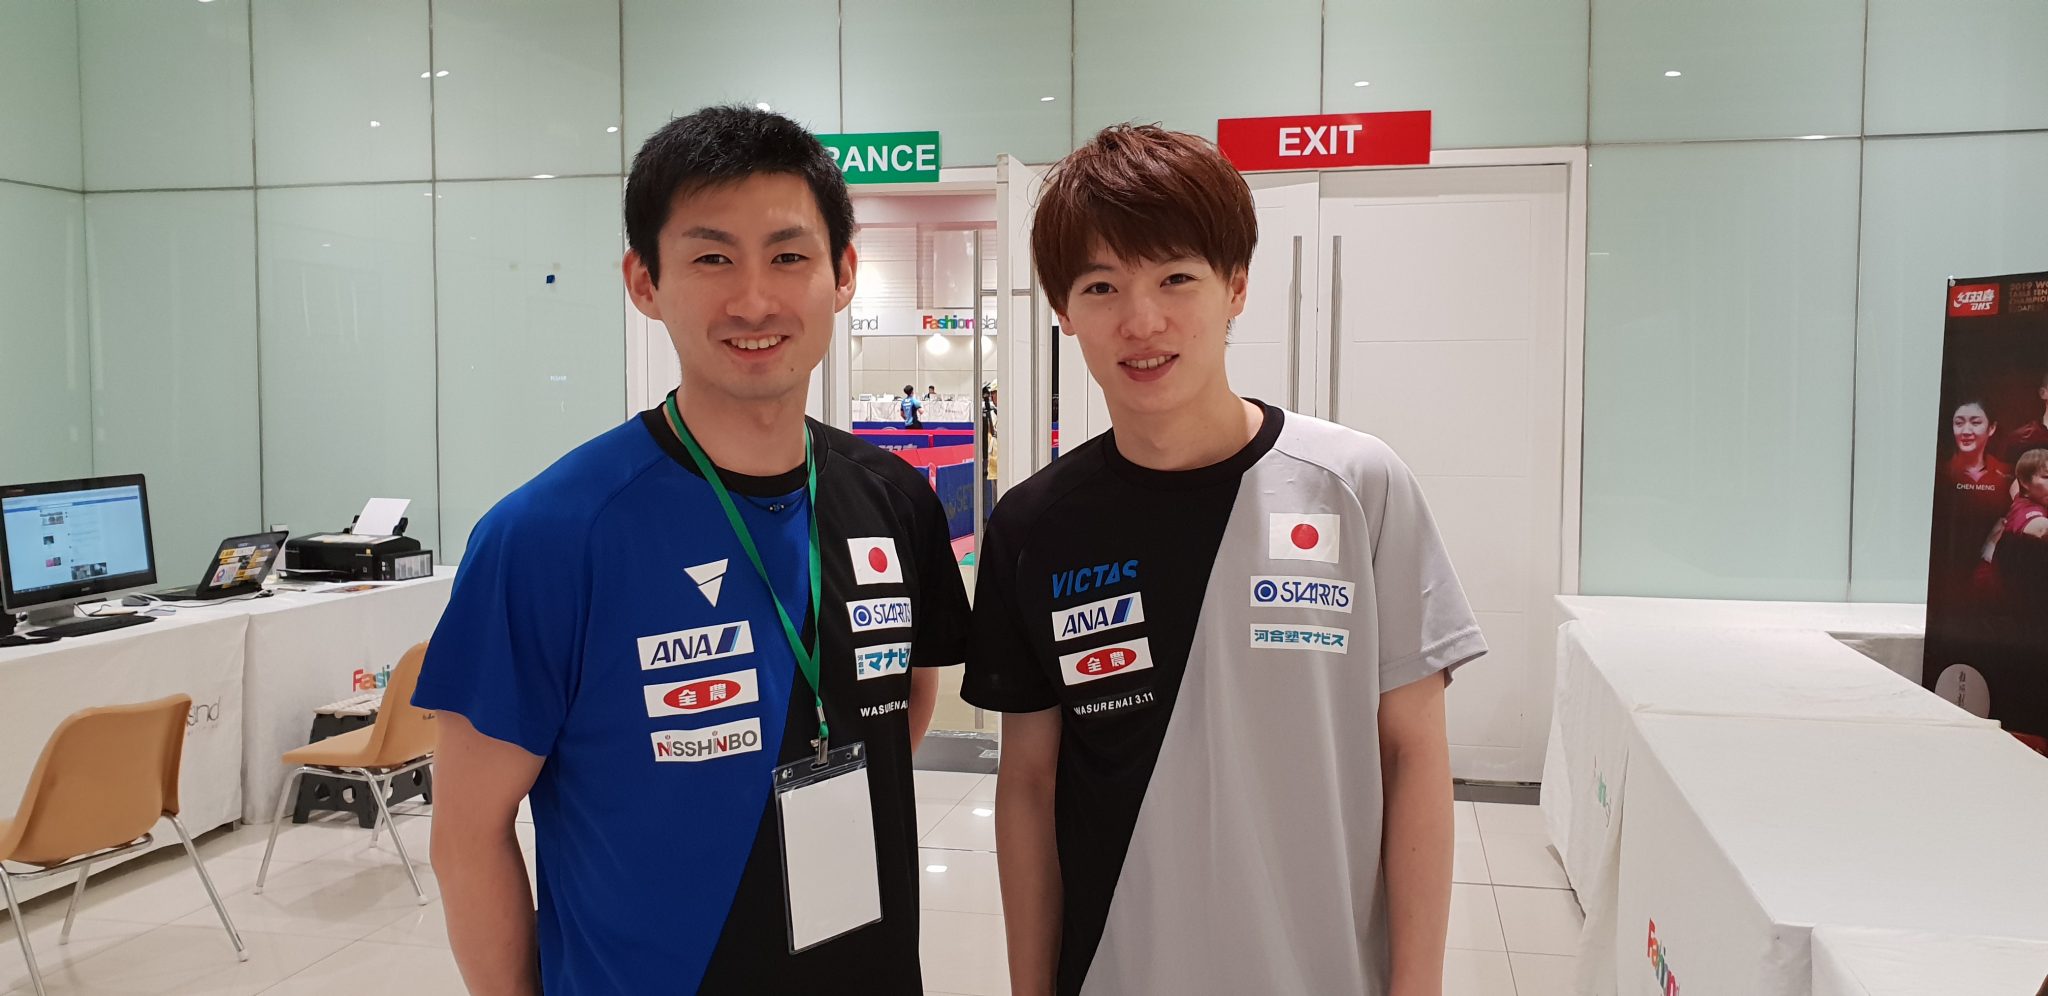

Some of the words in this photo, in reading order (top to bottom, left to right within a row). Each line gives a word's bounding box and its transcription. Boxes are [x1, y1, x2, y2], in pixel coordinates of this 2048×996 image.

[1279, 124, 1363, 157] EXIT
[824, 144, 936, 173] RANCE
[851, 315, 878, 330] land
[923, 315, 975, 329] Fashion
[1052, 559, 1139, 599] VICTAS
[1280, 582, 1349, 607] STARTS
[1062, 606, 1109, 637] ANA
[650, 633, 713, 665] ANA
[1073, 696, 1133, 716] WASURENAI
[1135, 691, 1155, 704] 3.11
